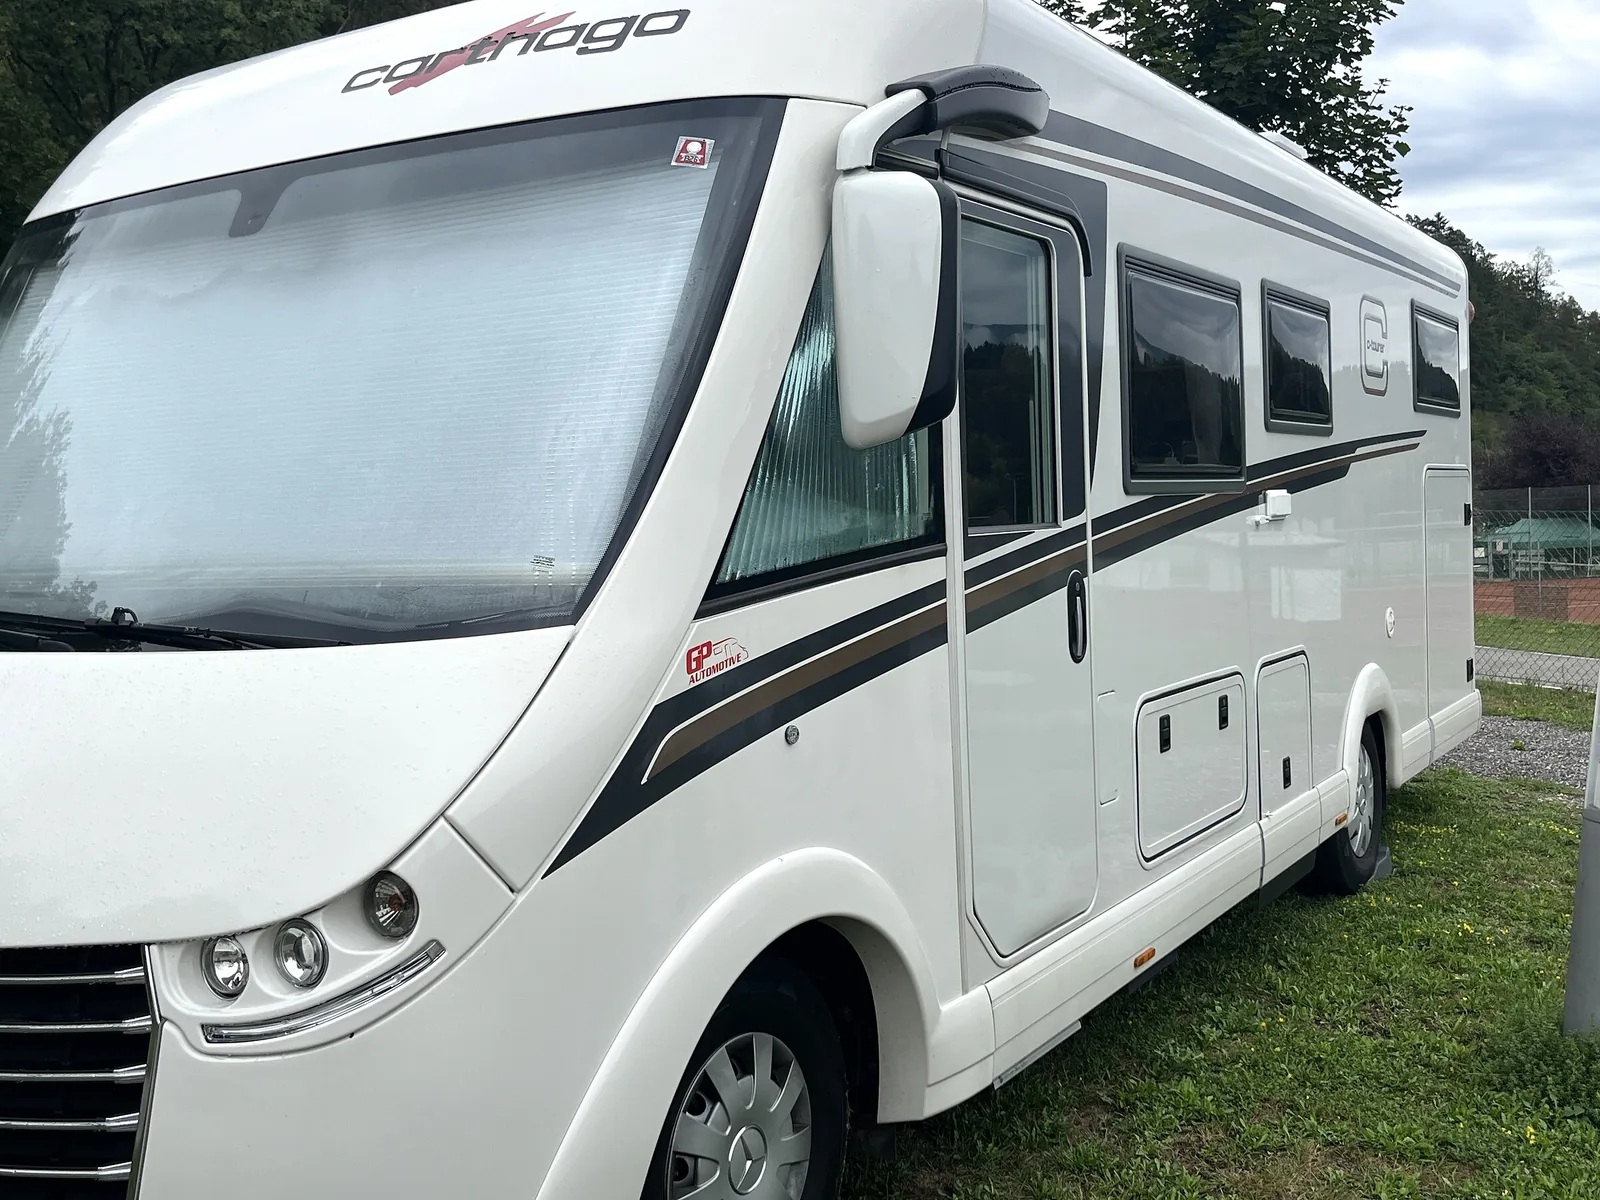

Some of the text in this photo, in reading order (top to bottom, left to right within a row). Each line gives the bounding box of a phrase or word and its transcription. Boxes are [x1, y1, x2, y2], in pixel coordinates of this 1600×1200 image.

[341, 9, 691, 93] carthago
[686, 641, 712, 675] GP
[689, 653, 742, 685] AUTOMOTIVE
